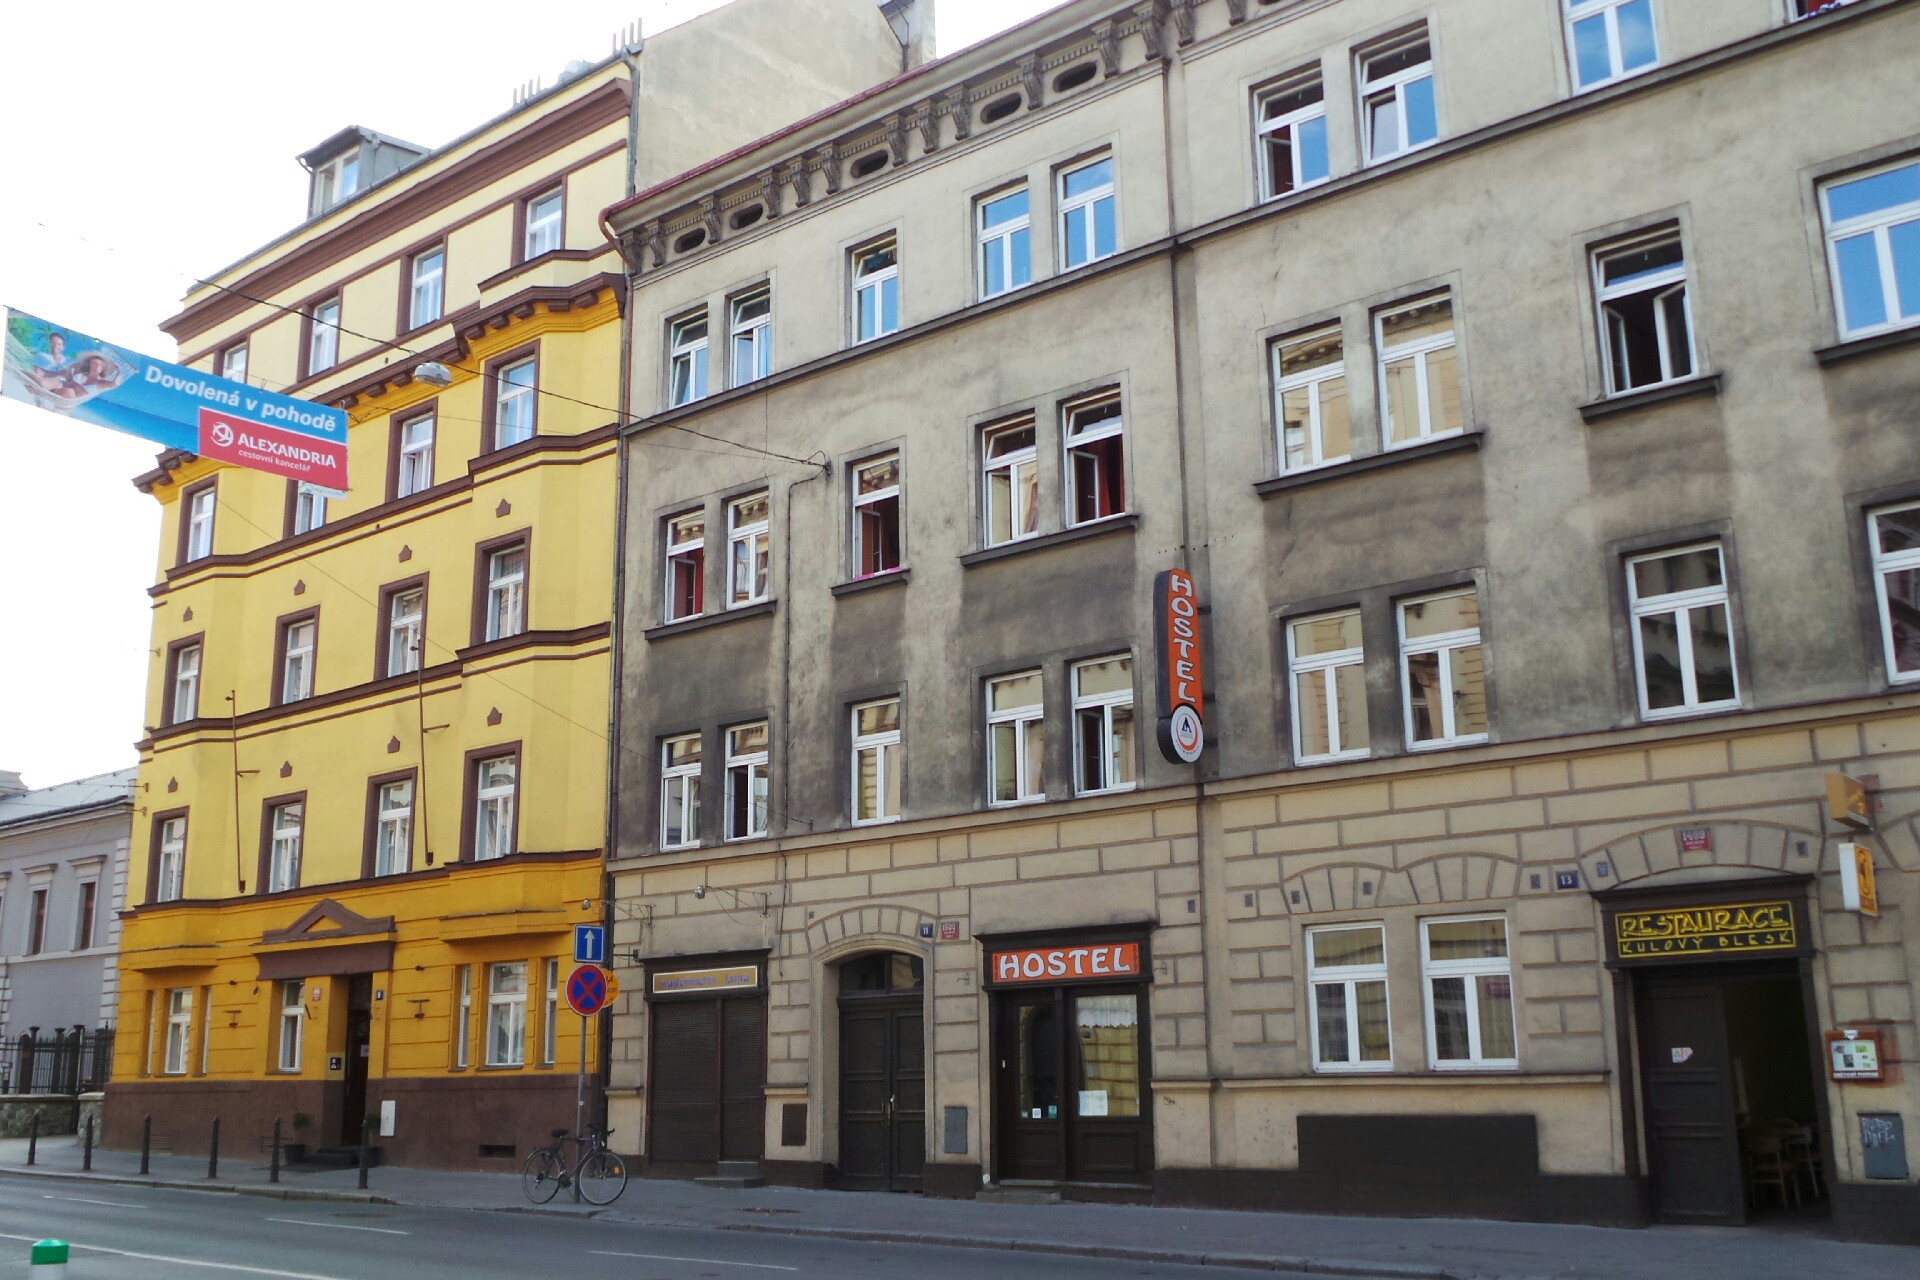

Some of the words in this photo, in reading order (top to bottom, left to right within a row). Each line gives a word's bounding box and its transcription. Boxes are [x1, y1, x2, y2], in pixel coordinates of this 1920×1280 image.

[145, 365, 240, 407] Dovolená
[244, 398, 258, 412] v
[261, 403, 336, 433] pohodě
[237, 432, 337, 469] ALEXANDRIA
[238, 449, 273, 464] cestovní
[275, 457, 311, 472] kancelář
[1171, 574, 1196, 703] HOSTEL
[1560, 874, 1572, 886] 13
[1622, 907, 1789, 938] RESTAURACE
[1622, 934, 1704, 954] KULOVÝ
[1719, 931, 1791, 947] BLESK
[1000, 947, 1131, 979] HOSTEL
